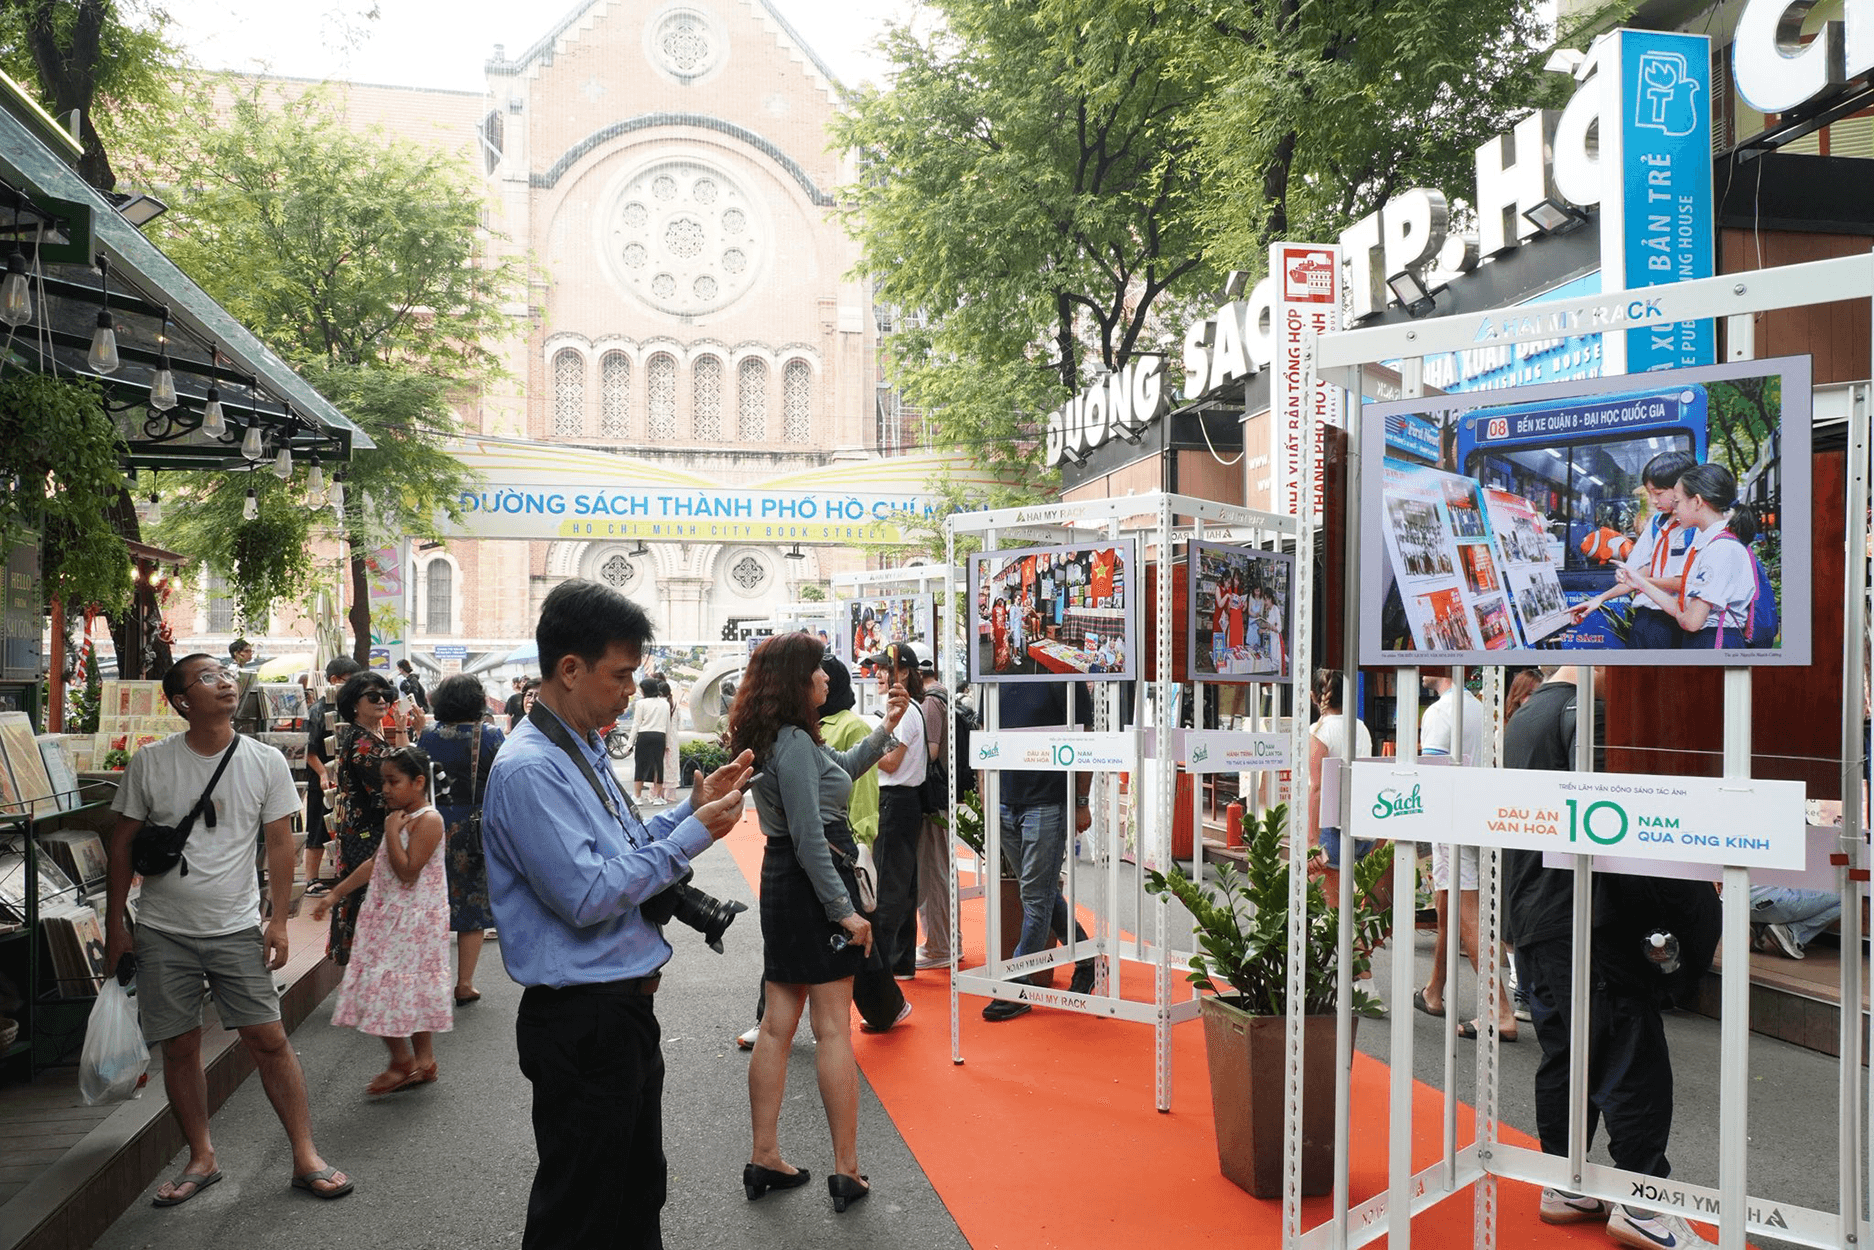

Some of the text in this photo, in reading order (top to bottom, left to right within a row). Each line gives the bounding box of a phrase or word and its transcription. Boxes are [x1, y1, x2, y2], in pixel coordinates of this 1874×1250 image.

[1641, 152, 1671, 203] TRẺ
[1678, 194, 1694, 248] HOUSE
[1340, 188, 1466, 320] TP.
[1641, 214, 1671, 271] BẢN
[1287, 308, 1307, 343] HỢP
[1504, 298, 1664, 338] HAI MY RACK
[1489, 419, 1507, 437] 08
[1517, 414, 1534, 434] BẾN
[1535, 417, 1546, 431] XE
[1547, 411, 1571, 432] QUẬN
[1572, 413, 1579, 427] 8
[1584, 410, 1600, 429] ĐẠI
[1601, 408, 1620, 428] HỌC
[1621, 401, 1647, 424] QUỐC
[1649, 404, 1665, 418] GIA
[574, 490, 649, 516] SÁCH
[657, 492, 752, 518] THÀNH
[761, 495, 817, 520] PHỐ
[826, 496, 864, 520] HỒ
[1026, 512, 1042, 521] HAI
[1044, 510, 1058, 519] MY
[573, 523, 593, 534] HO
[608, 523, 638, 535] CHI
[653, 525, 696, 536] MINH
[711, 526, 751, 536] CITY
[766, 527, 808, 538] BOOK
[1052, 744, 1075, 766] 10
[1372, 783, 1423, 820] Sách
[1566, 799, 1628, 846] 10
[1638, 831, 1674, 844] QUA
[1028, 991, 1087, 1010] HAI MY RACK
